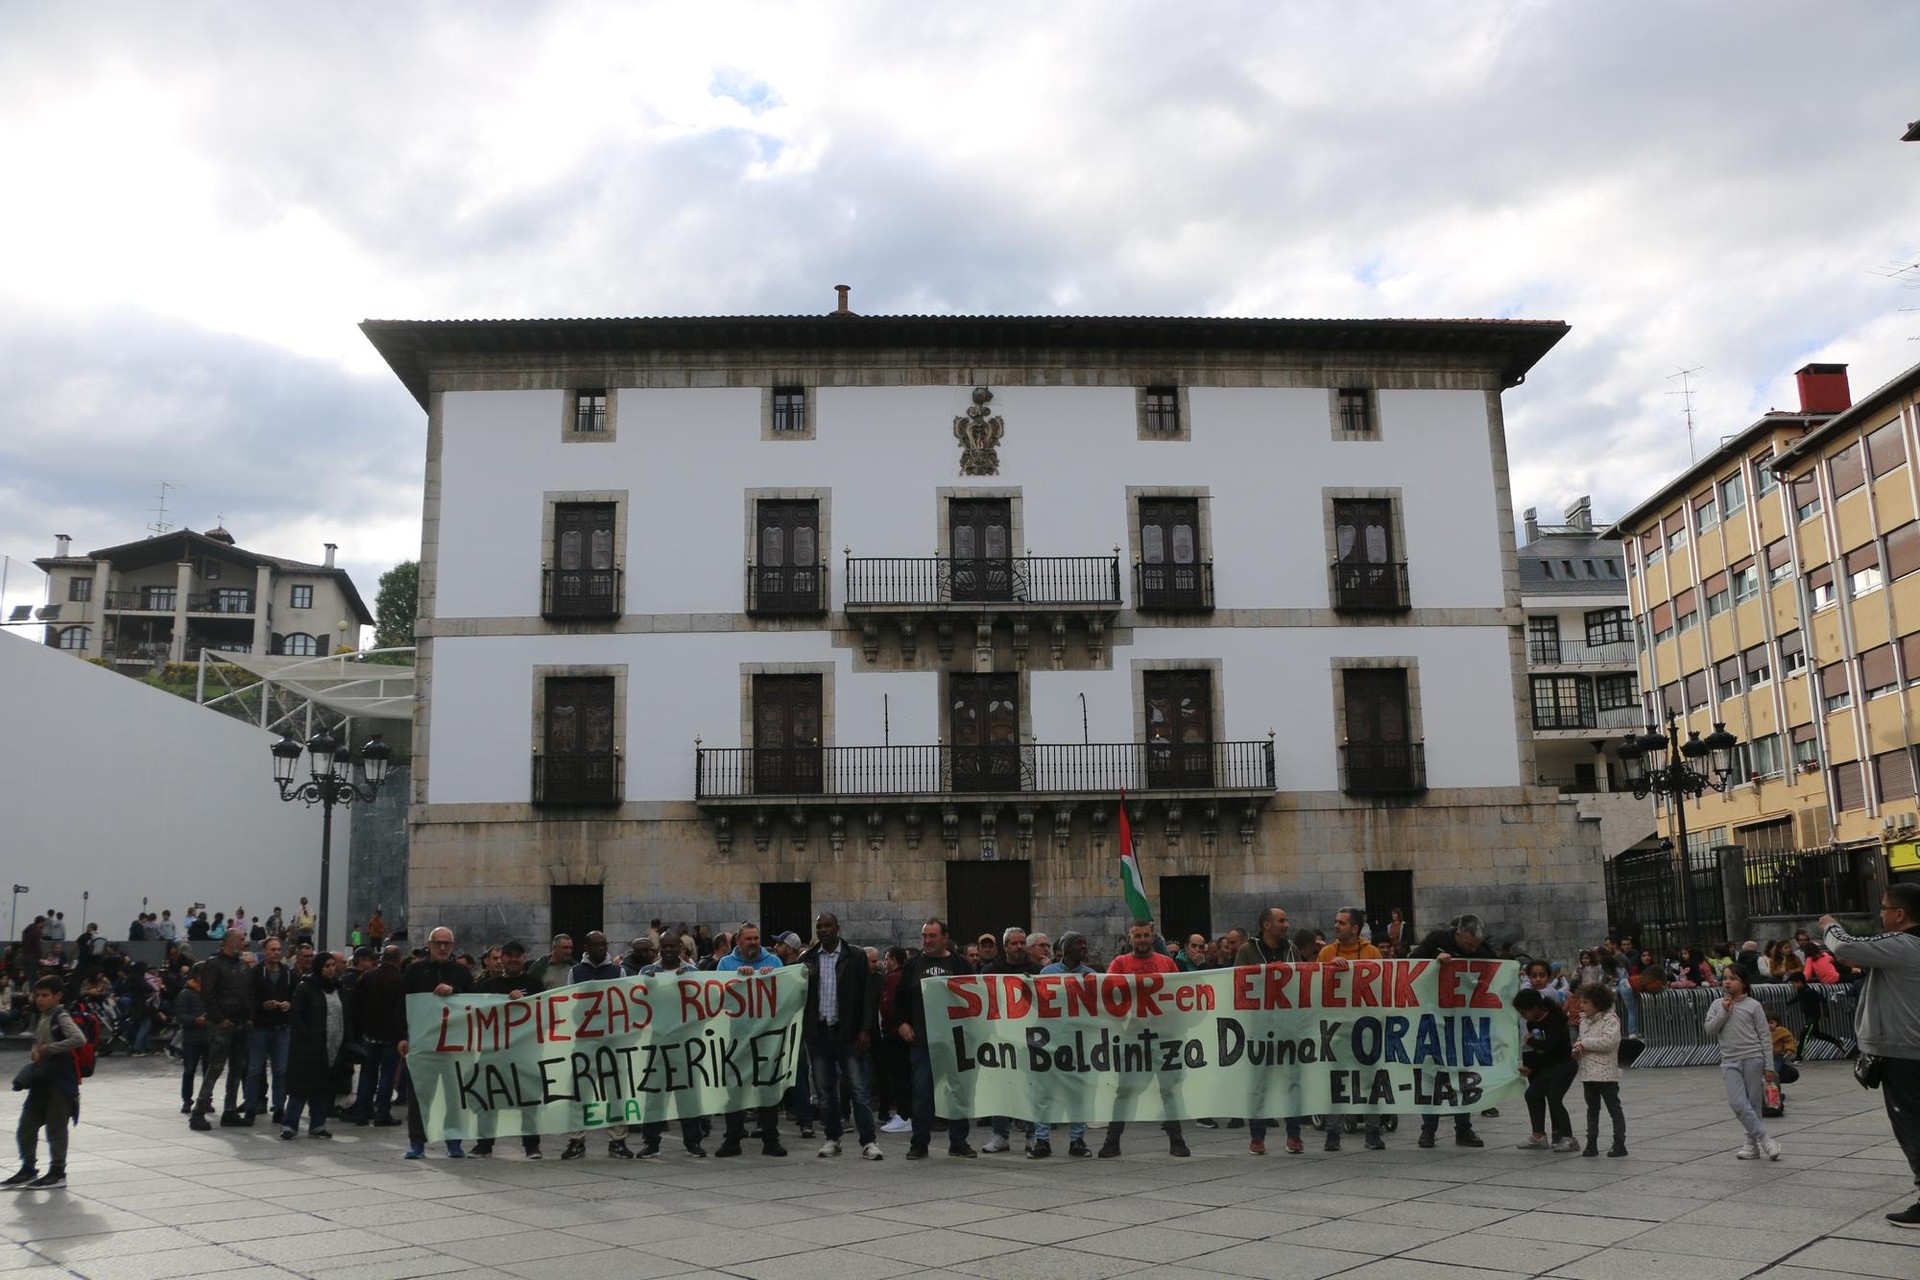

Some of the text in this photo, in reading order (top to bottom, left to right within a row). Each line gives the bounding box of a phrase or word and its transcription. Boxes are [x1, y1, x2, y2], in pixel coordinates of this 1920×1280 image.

[678, 974, 777, 1024] ROSIN
[946, 960, 1503, 1020] SIDENOR-en ERTERIK EZ
[952, 1025, 1017, 1072] Lan
[1351, 1014, 1493, 1067] ORAIN
[583, 1099, 641, 1126] ELA
[1330, 1068, 1482, 1107] ELA-LAB
